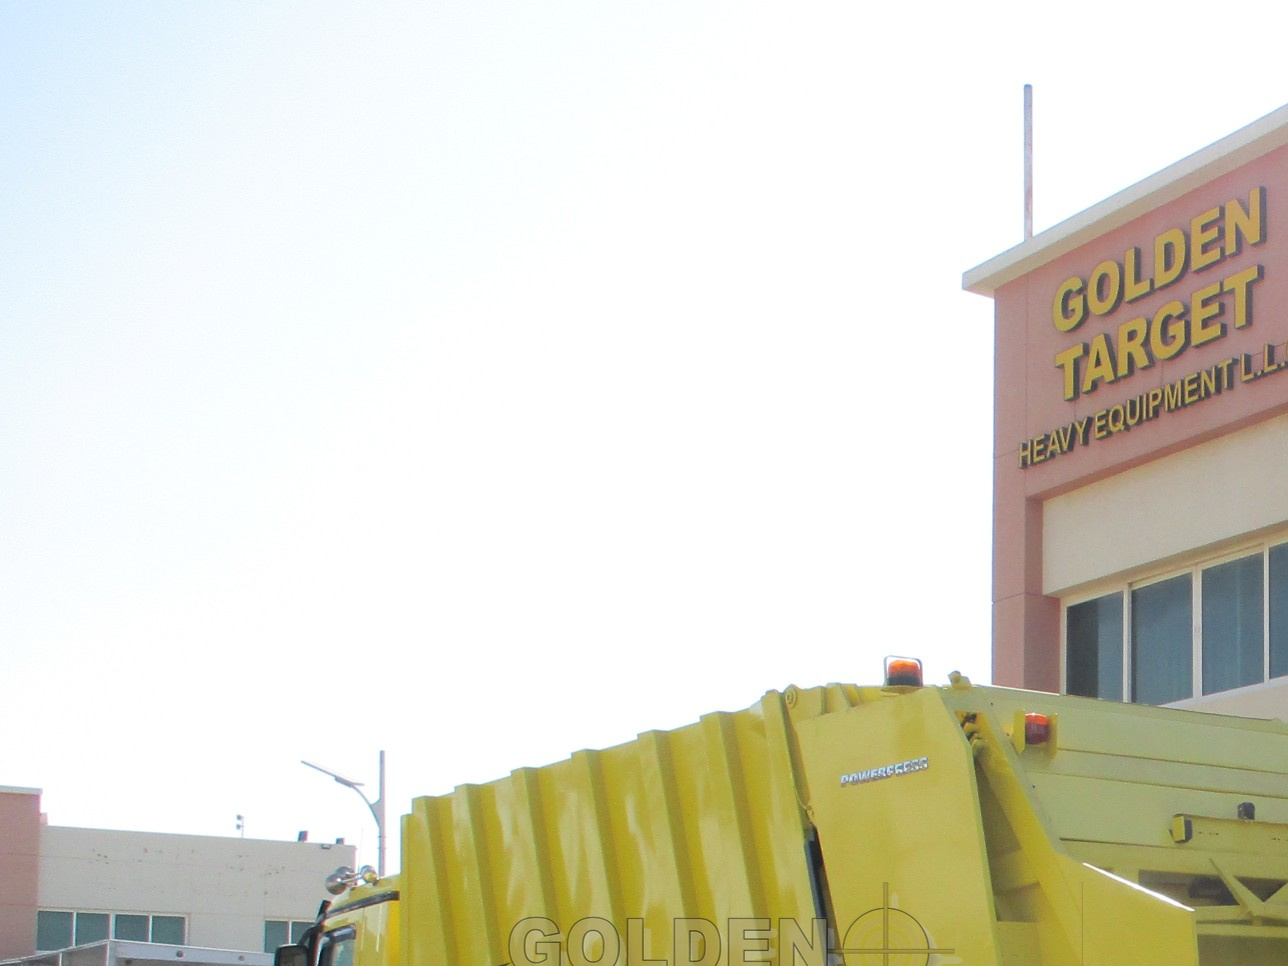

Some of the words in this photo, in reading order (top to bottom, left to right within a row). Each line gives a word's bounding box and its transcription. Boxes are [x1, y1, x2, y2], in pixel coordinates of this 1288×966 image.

[1052, 186, 1265, 333] GOLDEN
[1055, 264, 1263, 401] TARGET
[1018, 416, 1092, 469] HEAVY
[1094, 358, 1239, 440] EQUIPMENT
